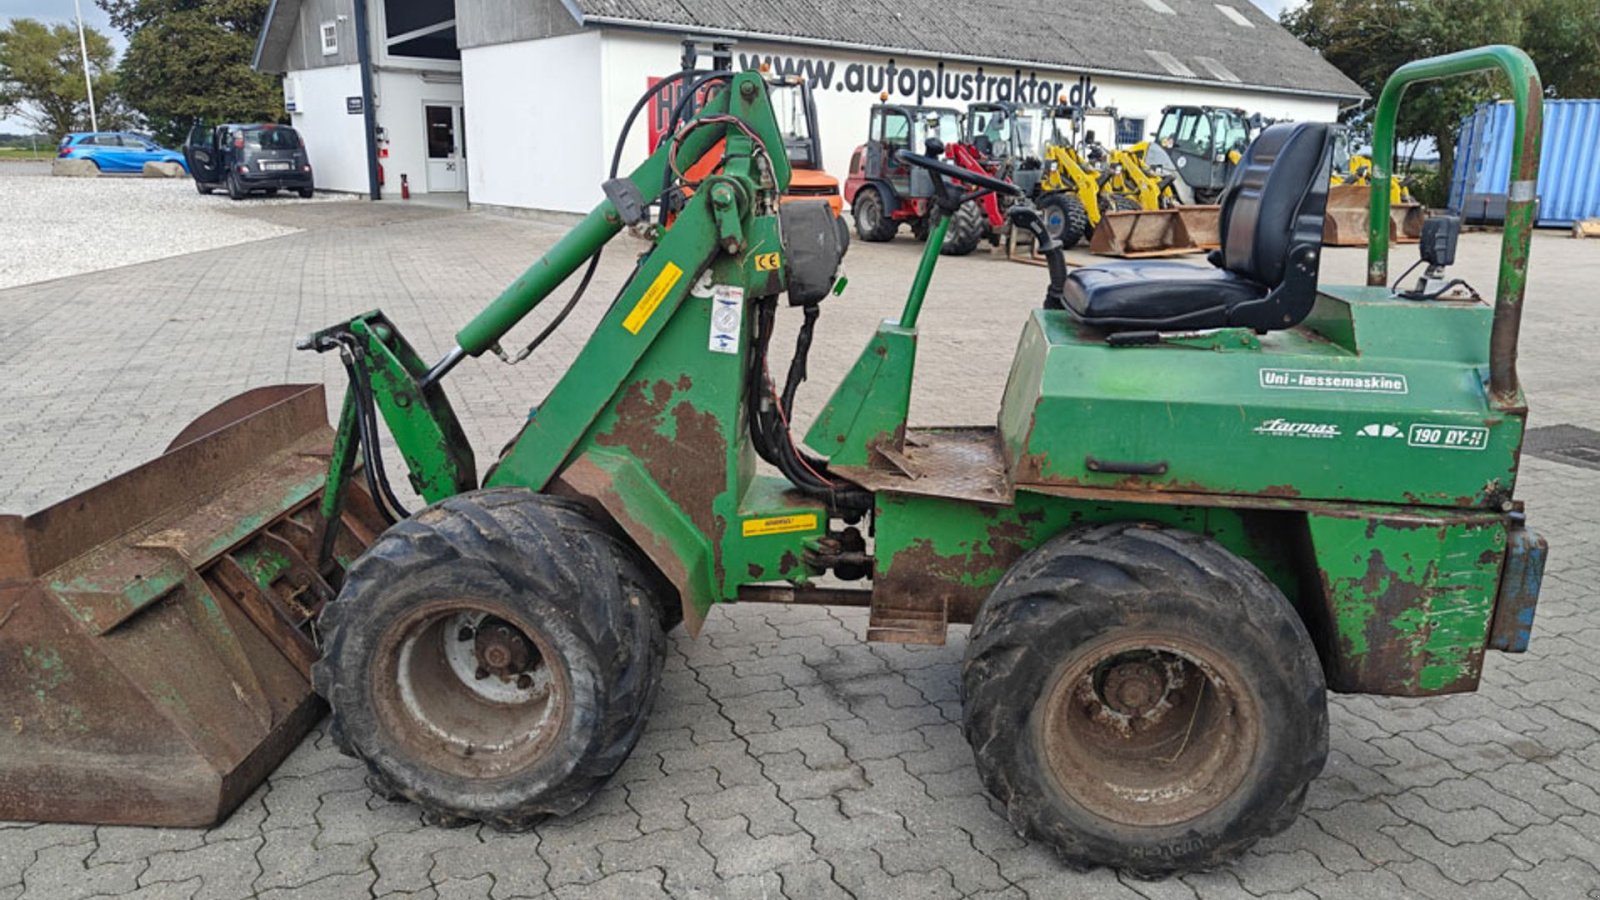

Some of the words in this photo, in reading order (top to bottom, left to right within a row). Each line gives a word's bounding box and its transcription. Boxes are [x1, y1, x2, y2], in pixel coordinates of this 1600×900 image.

[739, 53, 1097, 108] www.autoplustraktordk
[758, 253, 777, 269] CE
[1265, 372, 1289, 385] Uni
[1414, 428, 1441, 443] 190
